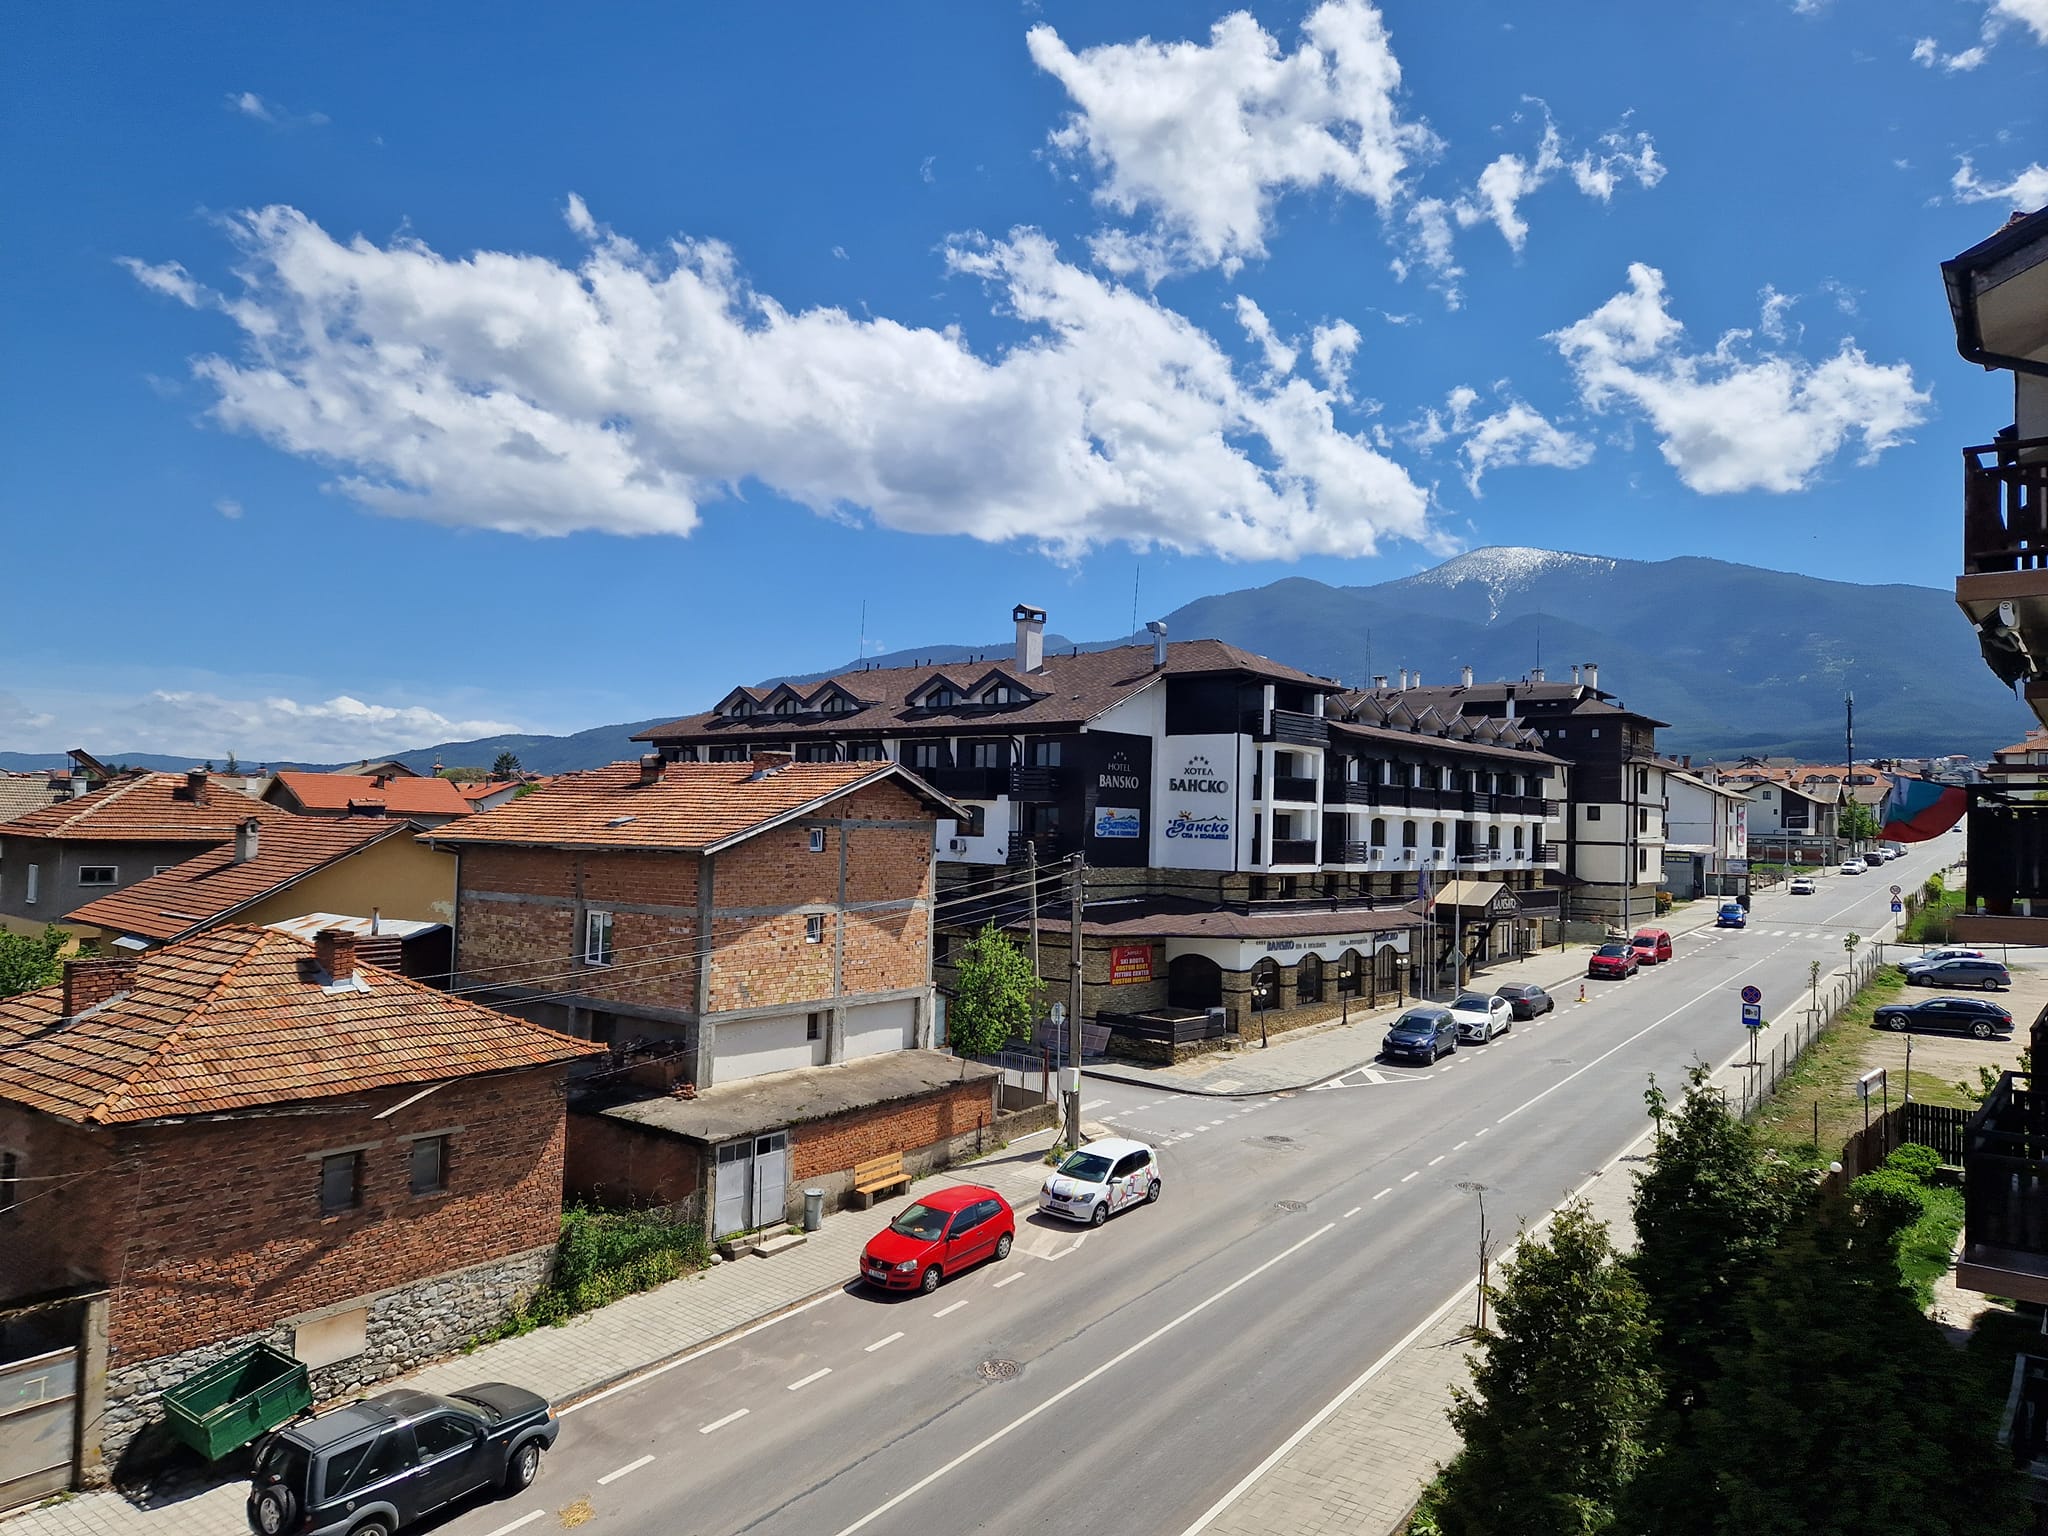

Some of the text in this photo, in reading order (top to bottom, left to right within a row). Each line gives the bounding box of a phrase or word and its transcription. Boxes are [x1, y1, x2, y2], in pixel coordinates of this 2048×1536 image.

[1108, 763, 1131, 771] HOTEL
[1184, 767, 1214, 776] ХОТЕЛ
[1099, 774, 1140, 789] BANSKO
[1169, 778, 1229, 794] БАНСКО
[1267, 940, 1294, 951] BANSKO
